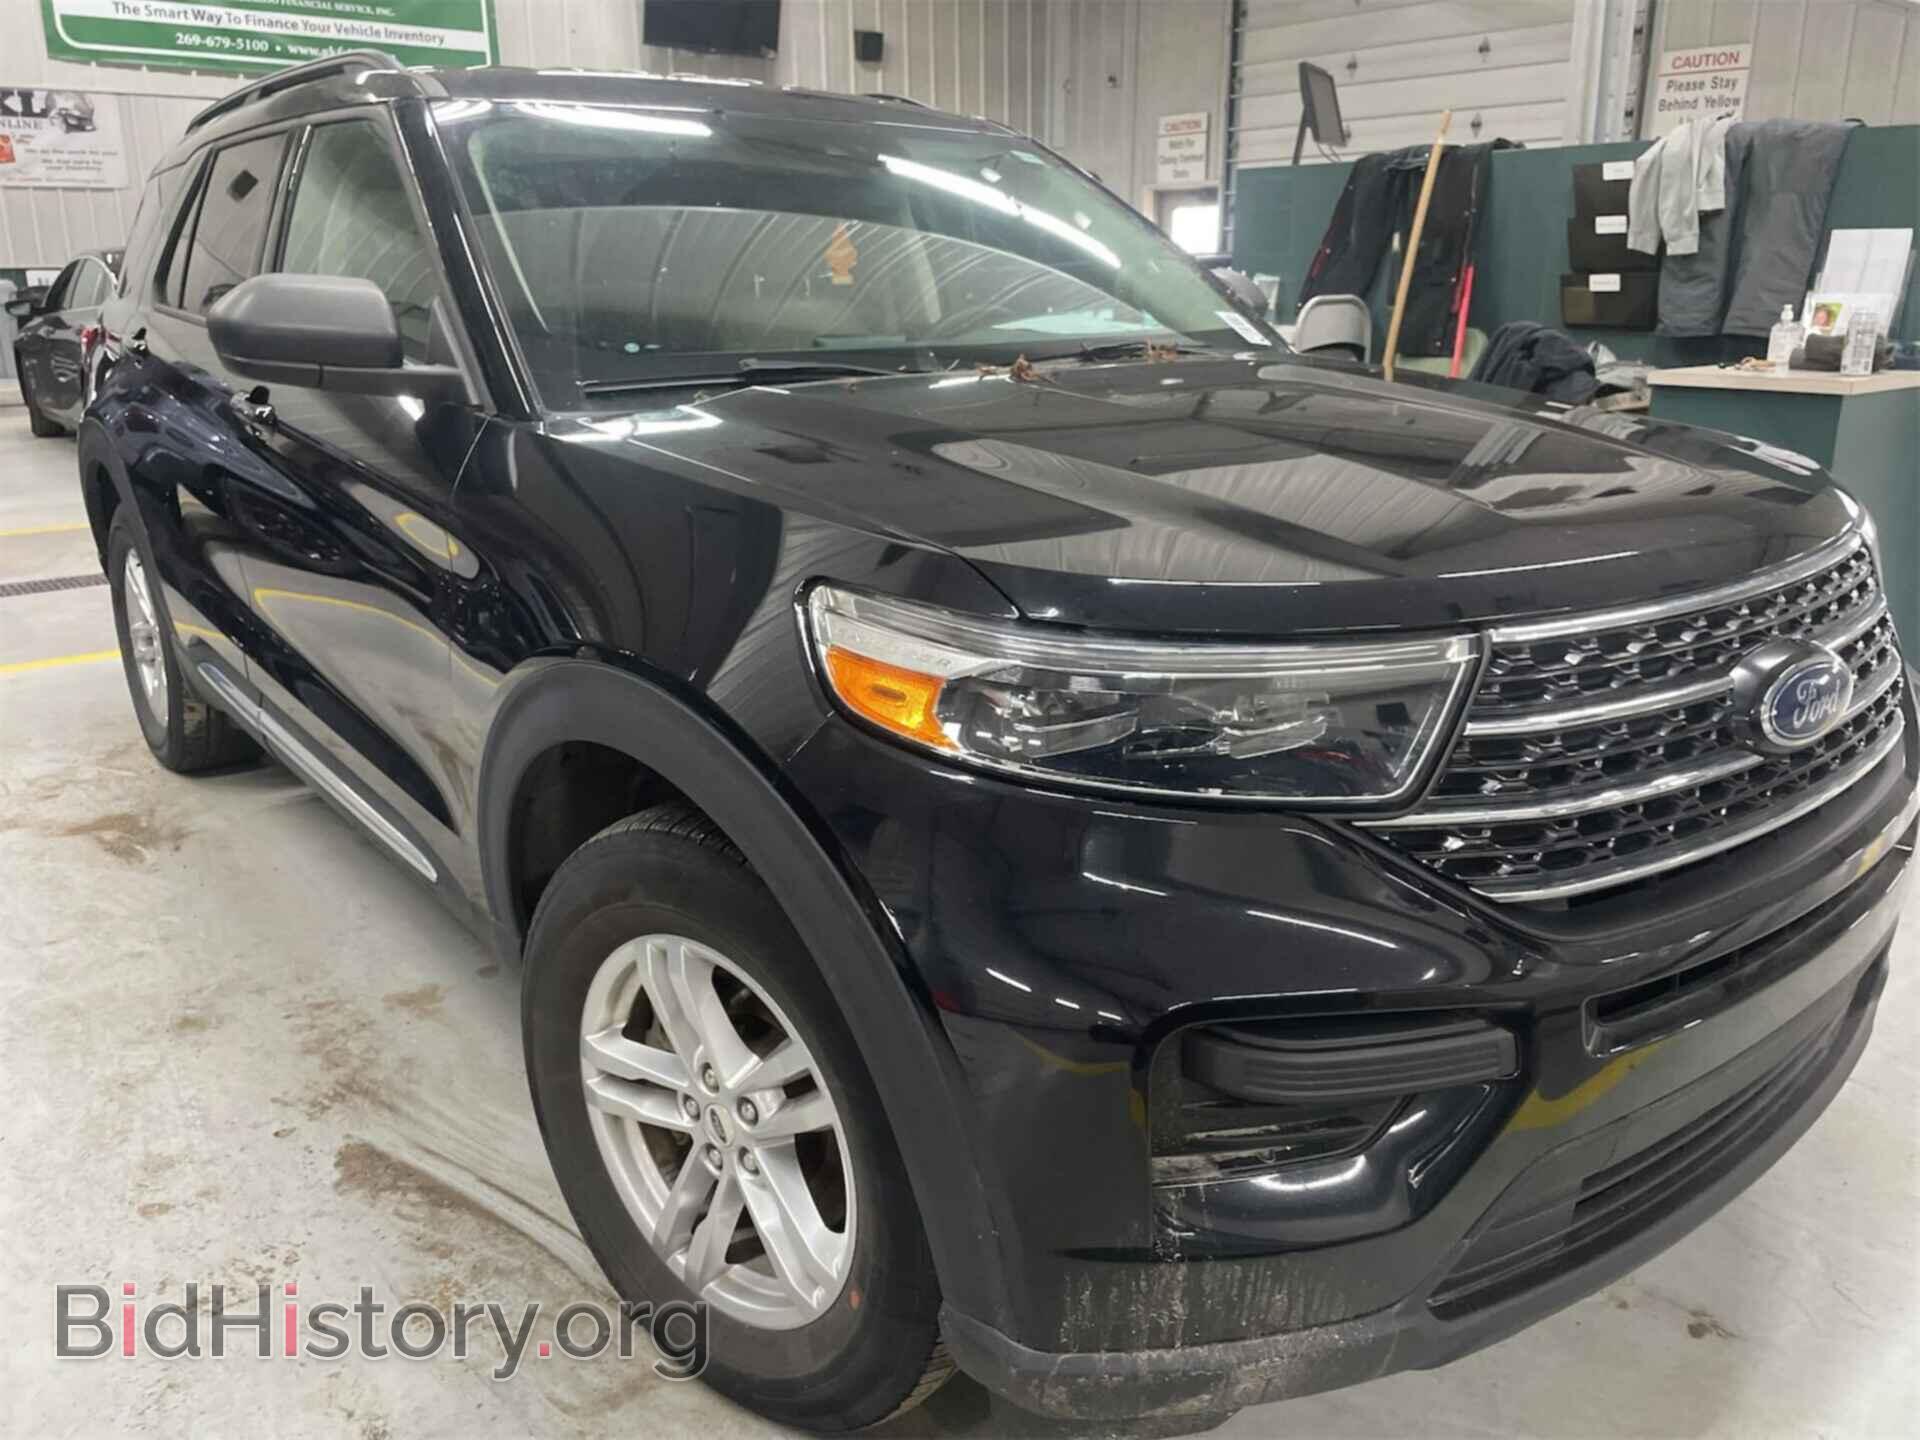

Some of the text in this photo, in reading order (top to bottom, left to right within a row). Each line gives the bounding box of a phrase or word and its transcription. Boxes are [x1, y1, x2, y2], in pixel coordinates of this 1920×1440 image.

[112, 2, 445, 45] The Smart Way To Finance Your Vehicle Inventory
[175, 32, 269, 52] 269-679-5100
[1671, 51, 1740, 70] CAUTION
[1665, 75, 1738, 93] Please Stay
[1657, 95, 1741, 113] Behind Yellow
[1793, 674, 1841, 729] Ford
